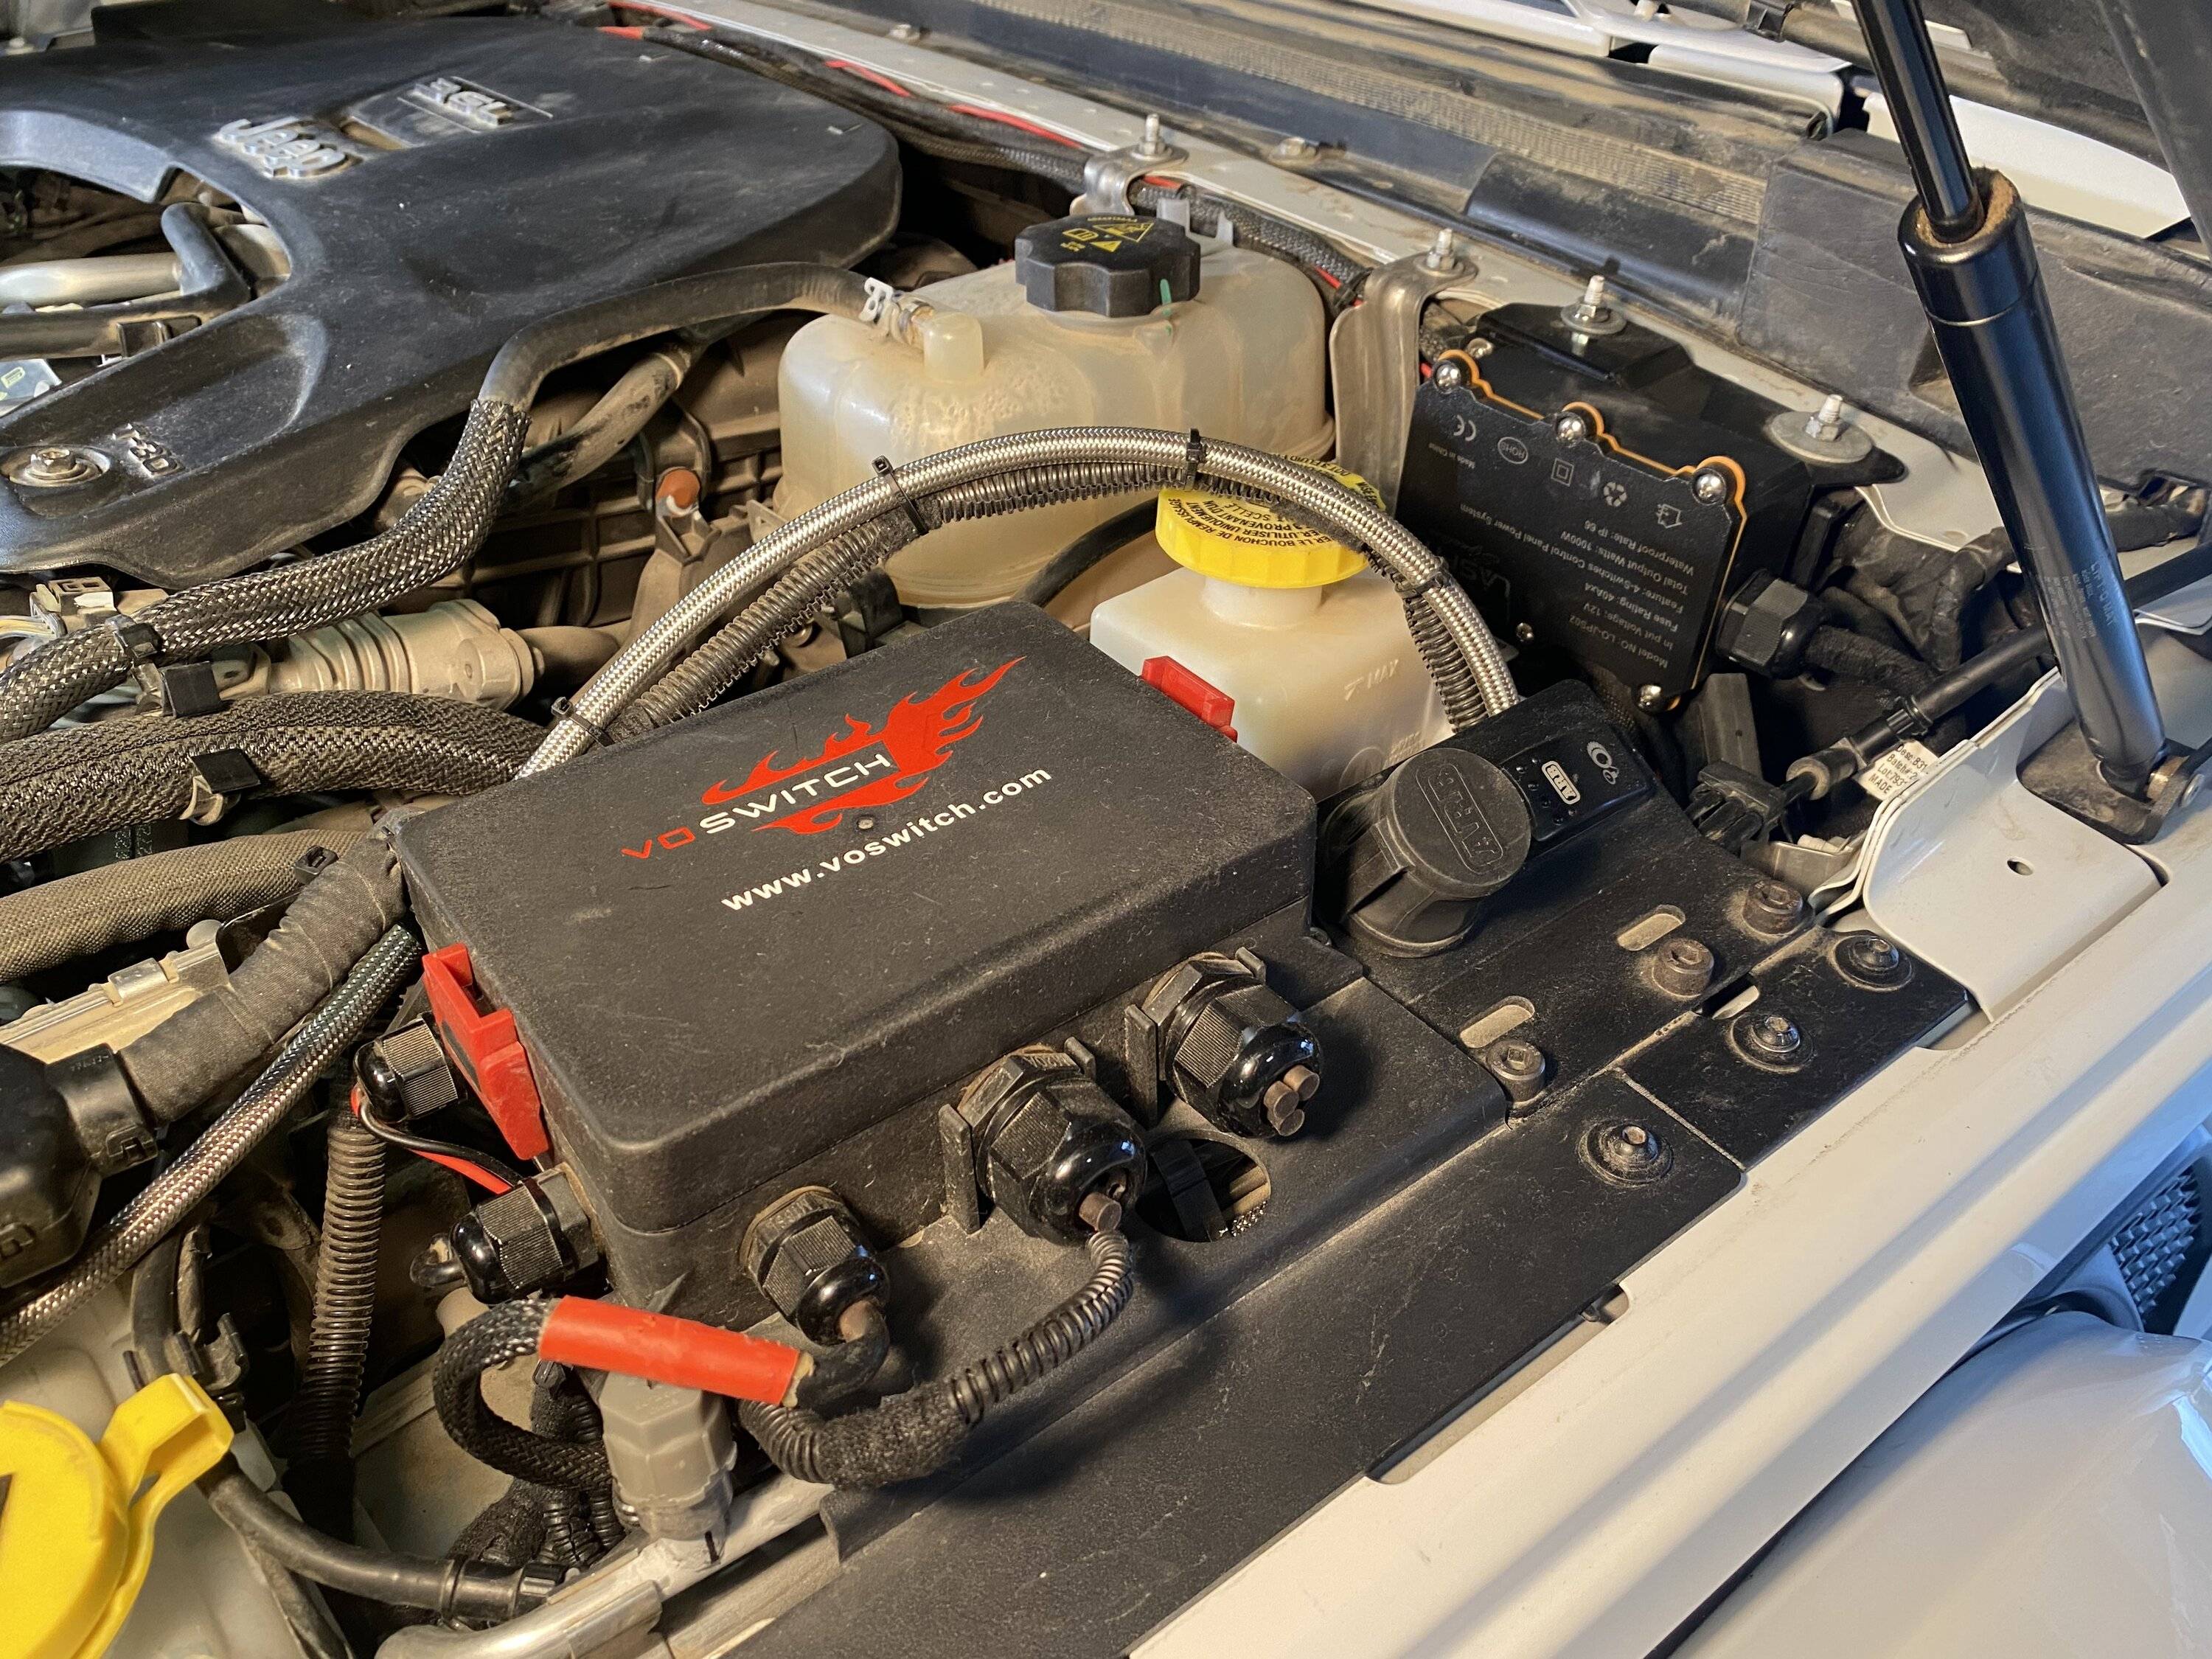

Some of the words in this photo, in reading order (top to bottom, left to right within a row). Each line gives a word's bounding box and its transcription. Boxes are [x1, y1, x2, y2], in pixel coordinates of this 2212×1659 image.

[217, 116, 347, 178] Jeep
[1428, 442, 1447, 456] China
[1457, 454, 1475, 470] Made
[1167, 497, 1215, 533] REMPLISSAGE
[1185, 501, 1239, 532] UNIQUEMENT
[1216, 512, 1290, 530] PROVENANT
[1460, 504, 1492, 526] System
[1217, 531, 1233, 539] DE
[1234, 535, 1295, 547] BOUCHON
[1242, 529, 1296, 539] UTILISER
[1494, 521, 1521, 540] Power
[1560, 530, 1593, 552] 1000W
[1597, 527, 1608, 538] IP
[1298, 538, 1312, 546] LE
[1523, 533, 1549, 552] Panel
[1610, 532, 1636, 551] Rate:
[1551, 546, 1585, 568] Control
[1594, 546, 1625, 567] Watts:
[1637, 544, 1694, 576] Waterproof
[1587, 563, 1640, 593] 4-Switches
[1627, 560, 1661, 582] Output
[1585, 583, 1615, 602] 40Ax4
[1663, 577, 1688, 595] Total
[1583, 602, 1601, 616] 12V
[1616, 596, 1651, 619] Rating:
[1642, 589, 1683, 613] Feature:
[1604, 611, 1642, 636] Voltage:
[1654, 615, 1679, 633] Fuse
[1618, 638, 1637, 653] NO:
[1644, 630, 1661, 643] put
[1638, 646, 1669, 669] Model
[1368, 659, 1399, 689] MAX
[1546, 765, 1577, 801] ARB
[1868, 773, 1892, 794] MADE
[721, 766, 1052, 911] www.voswitch.com
